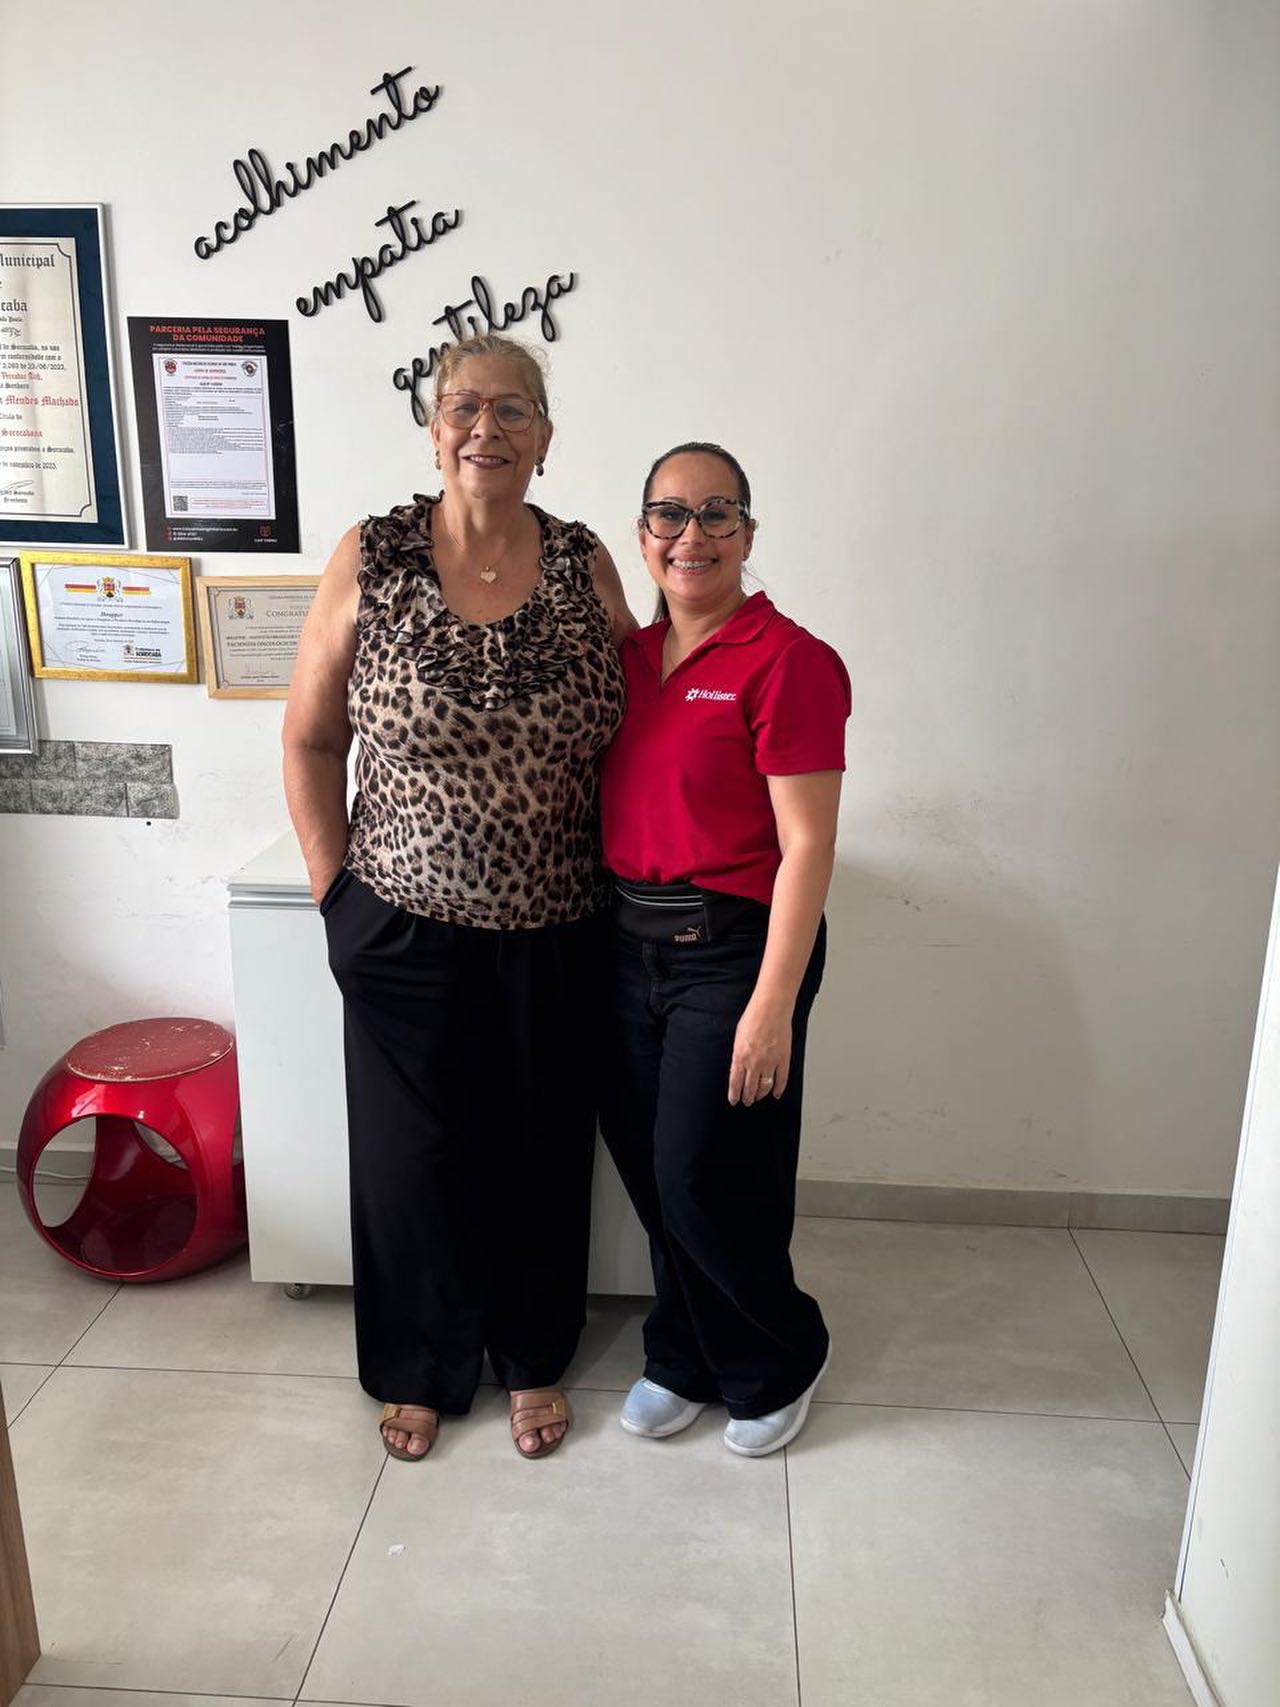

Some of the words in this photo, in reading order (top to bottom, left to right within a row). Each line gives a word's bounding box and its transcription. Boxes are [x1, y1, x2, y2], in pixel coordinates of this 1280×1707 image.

[194, 66, 441, 260] acolhimento
[296, 200, 460, 323] empatia
[149, 325, 192, 333] PARCERIA
[192, 326, 213, 334] PELA
[214, 326, 266, 337] SEGURANÇA
